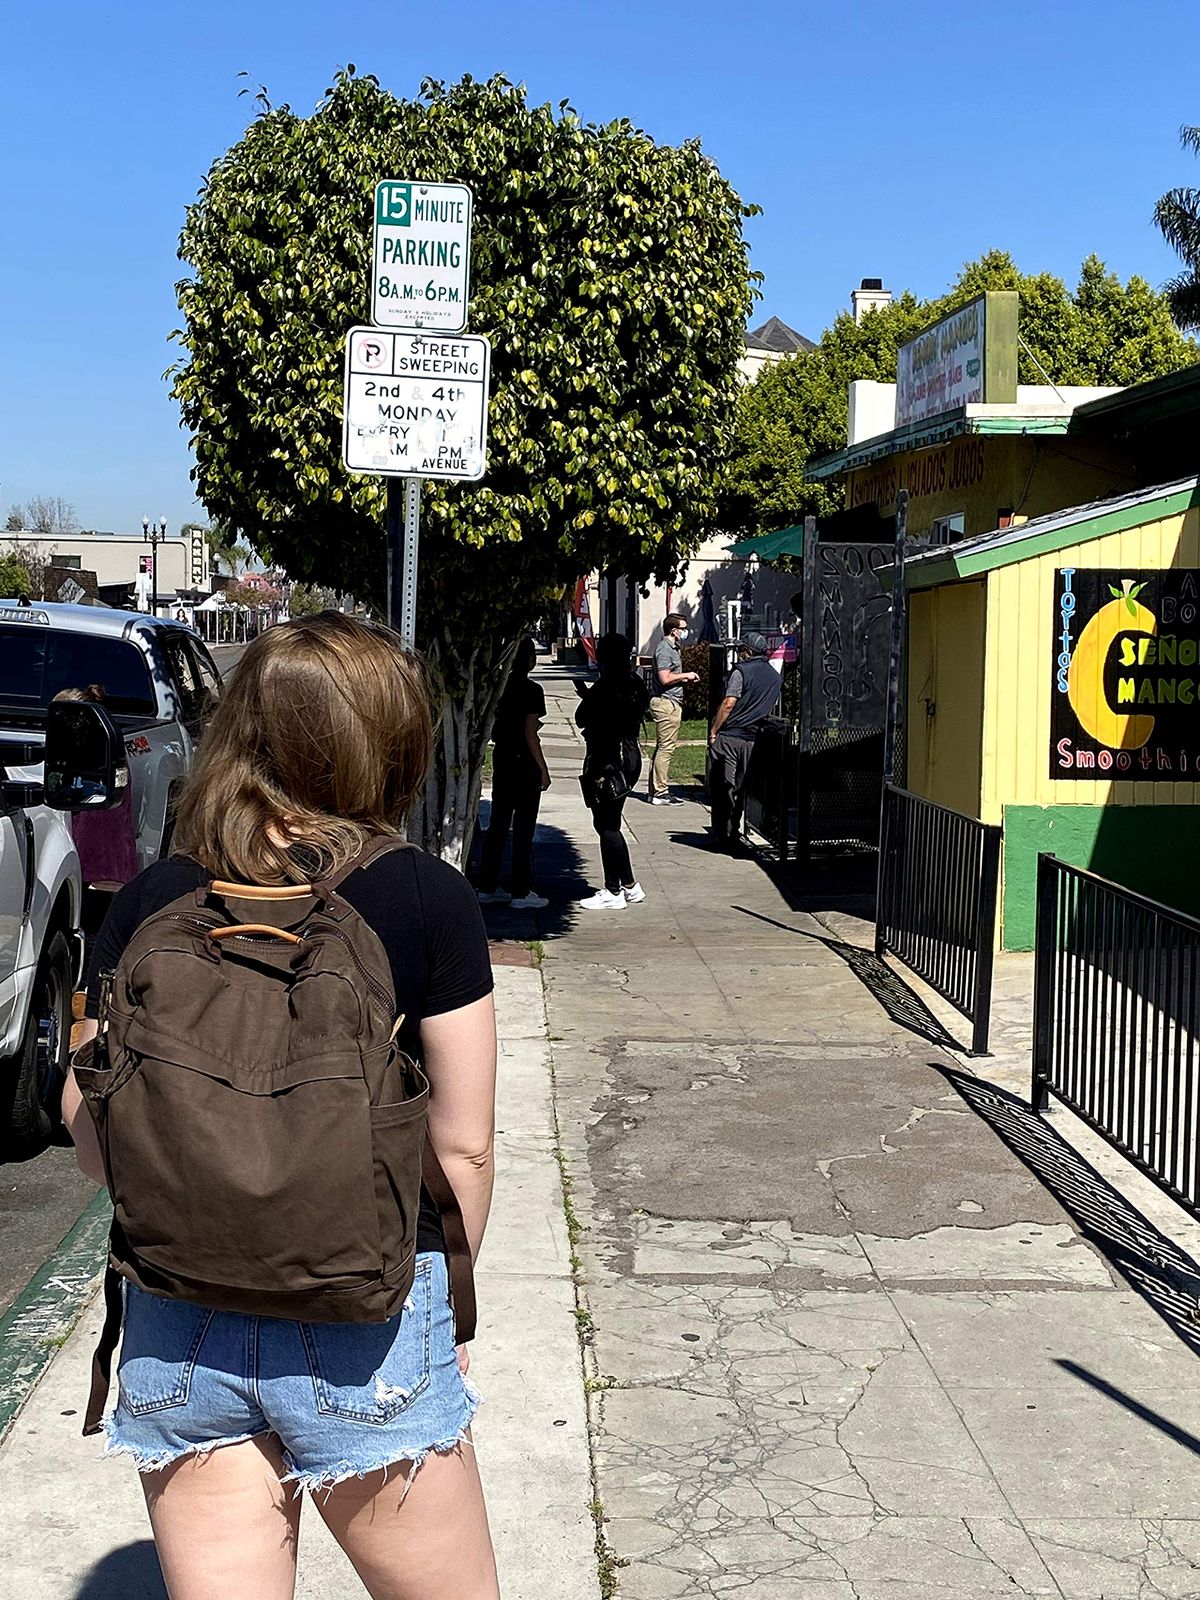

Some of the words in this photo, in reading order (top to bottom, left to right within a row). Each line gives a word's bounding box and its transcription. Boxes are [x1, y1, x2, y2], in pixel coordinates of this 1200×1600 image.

[381, 186, 408, 219] 15
[415, 199, 464, 223] MINUTE
[382, 237, 461, 268] PARKING
[410, 342, 470, 358] STREET
[400, 358, 479, 375] SWEEPING
[364, 381, 401, 398] 2nd
[431, 386, 465, 402] 4th
[378, 404, 458, 423] MONDAY
[438, 446, 462, 459] PM
[421, 458, 468, 471] AVENUE
[1118, 633, 1200, 667] SEÑO
[1117, 677, 1200, 704] MANG
[1057, 738, 1200, 772] Smoothi
